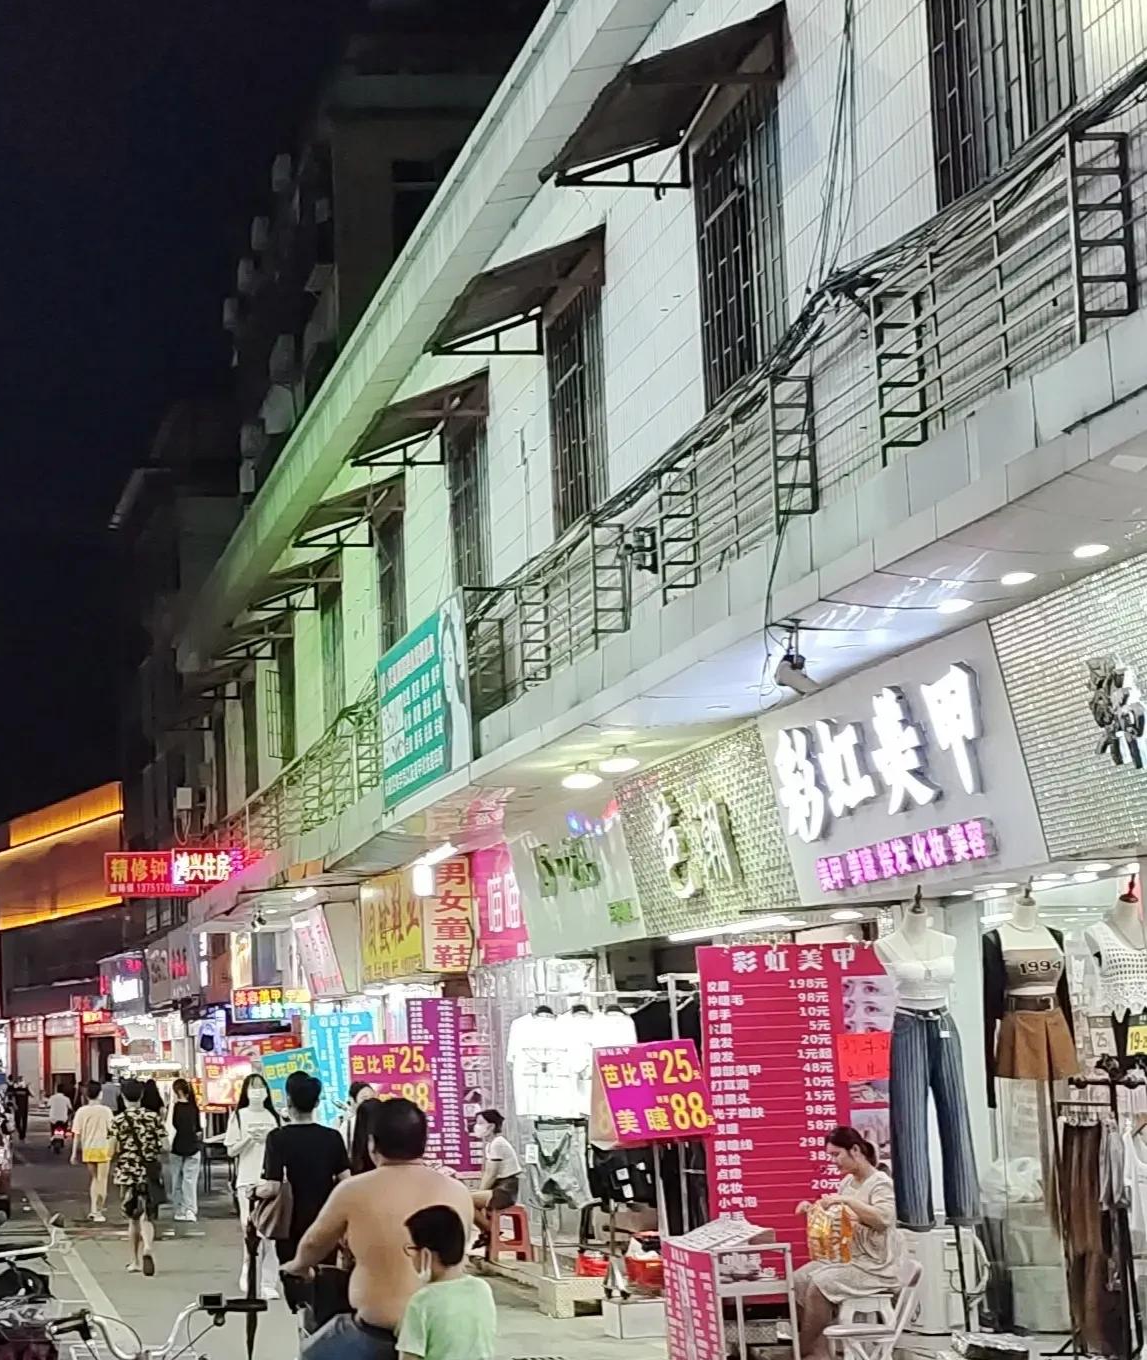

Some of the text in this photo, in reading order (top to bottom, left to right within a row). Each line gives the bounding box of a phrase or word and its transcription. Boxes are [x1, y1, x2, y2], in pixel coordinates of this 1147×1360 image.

[774, 663, 980, 844] 彩虹美甲
[430, 861, 473, 969] 男女童鞋
[731, 947, 856, 974] 彩虹美甲
[1019, 960, 1062, 976] 1994
[788, 977, 829, 990] 198元
[797, 991, 829, 1003] 98元
[799, 1005, 830, 1018] 10元
[809, 1019, 831, 1031] 5元
[801, 1034, 832, 1045] 20元
[796, 1048, 833, 1060] 1元起
[351, 1054, 396, 1075] 芭比甲
[802, 1062, 834, 1074] 48元
[600, 1061, 658, 1089] 芭比甲
[710, 1076, 835, 1092] 打耳洞 10元
[804, 1090, 836, 1102] 15元
[805, 1104, 837, 1116] 98元
[806, 1119, 838, 1131] 58元
[717, 1179, 842, 1195] 化妆 20元
[718, 1196, 758, 1209] 小气泡
